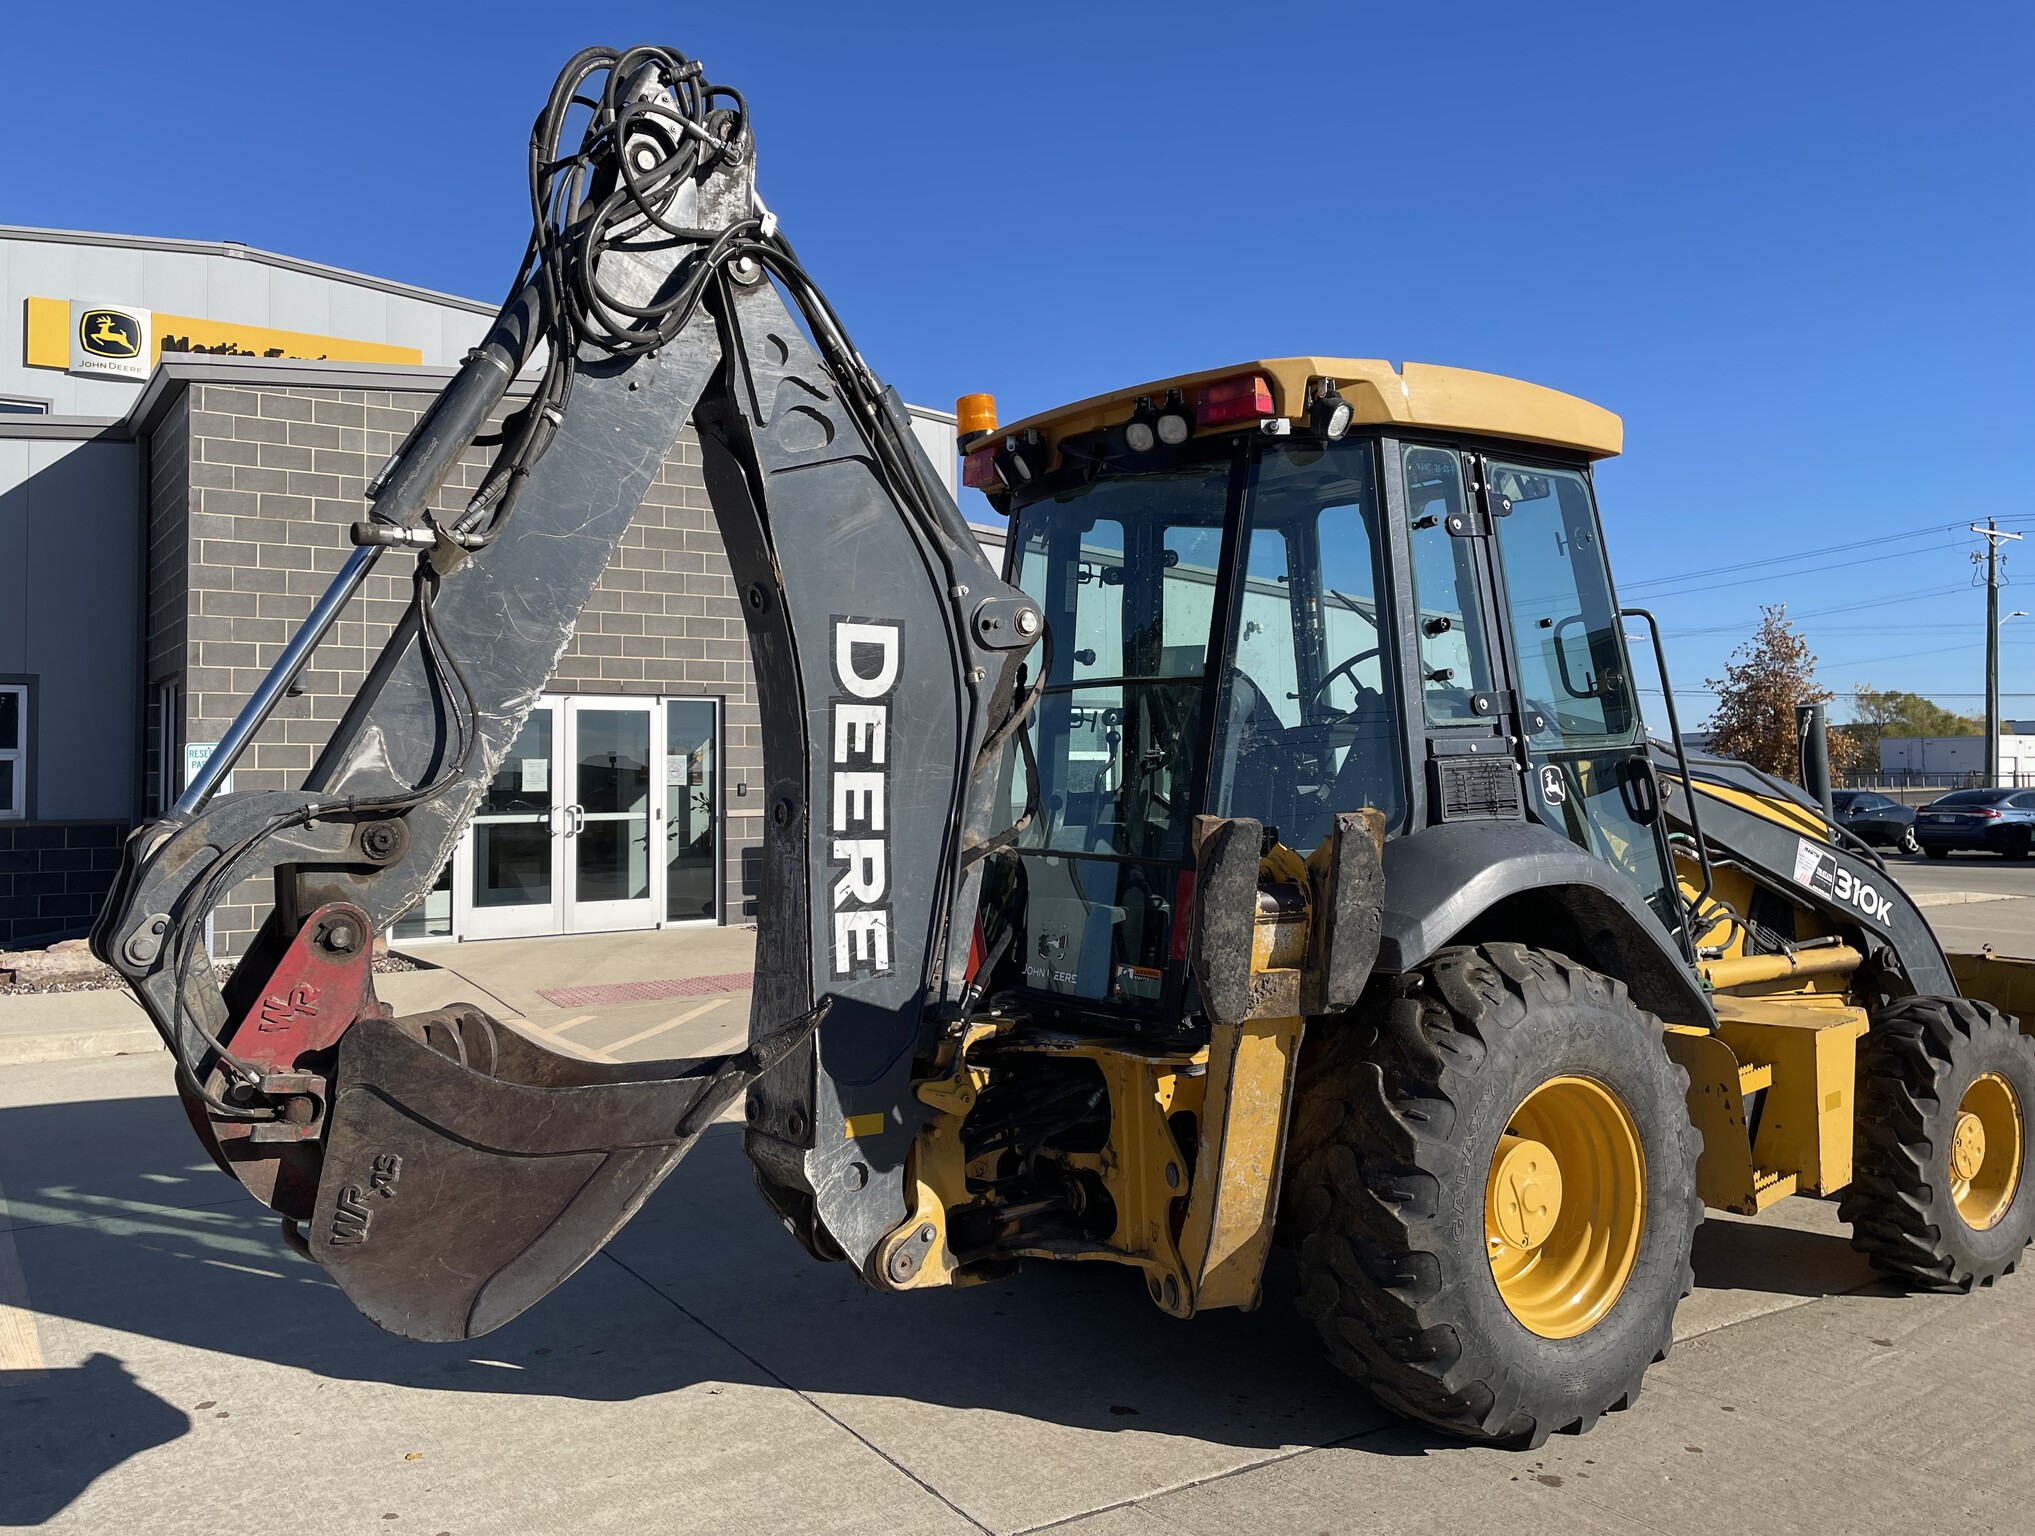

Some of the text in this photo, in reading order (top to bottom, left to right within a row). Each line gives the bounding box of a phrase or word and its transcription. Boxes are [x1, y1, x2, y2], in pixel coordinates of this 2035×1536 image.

[78, 360, 143, 374] JOHN DEERE
[832, 622, 900, 974] DEERE
[1834, 867, 1893, 927] 310K
[1021, 963, 1046, 978] JOHN
[1452, 1083, 1496, 1243] GALAXY
